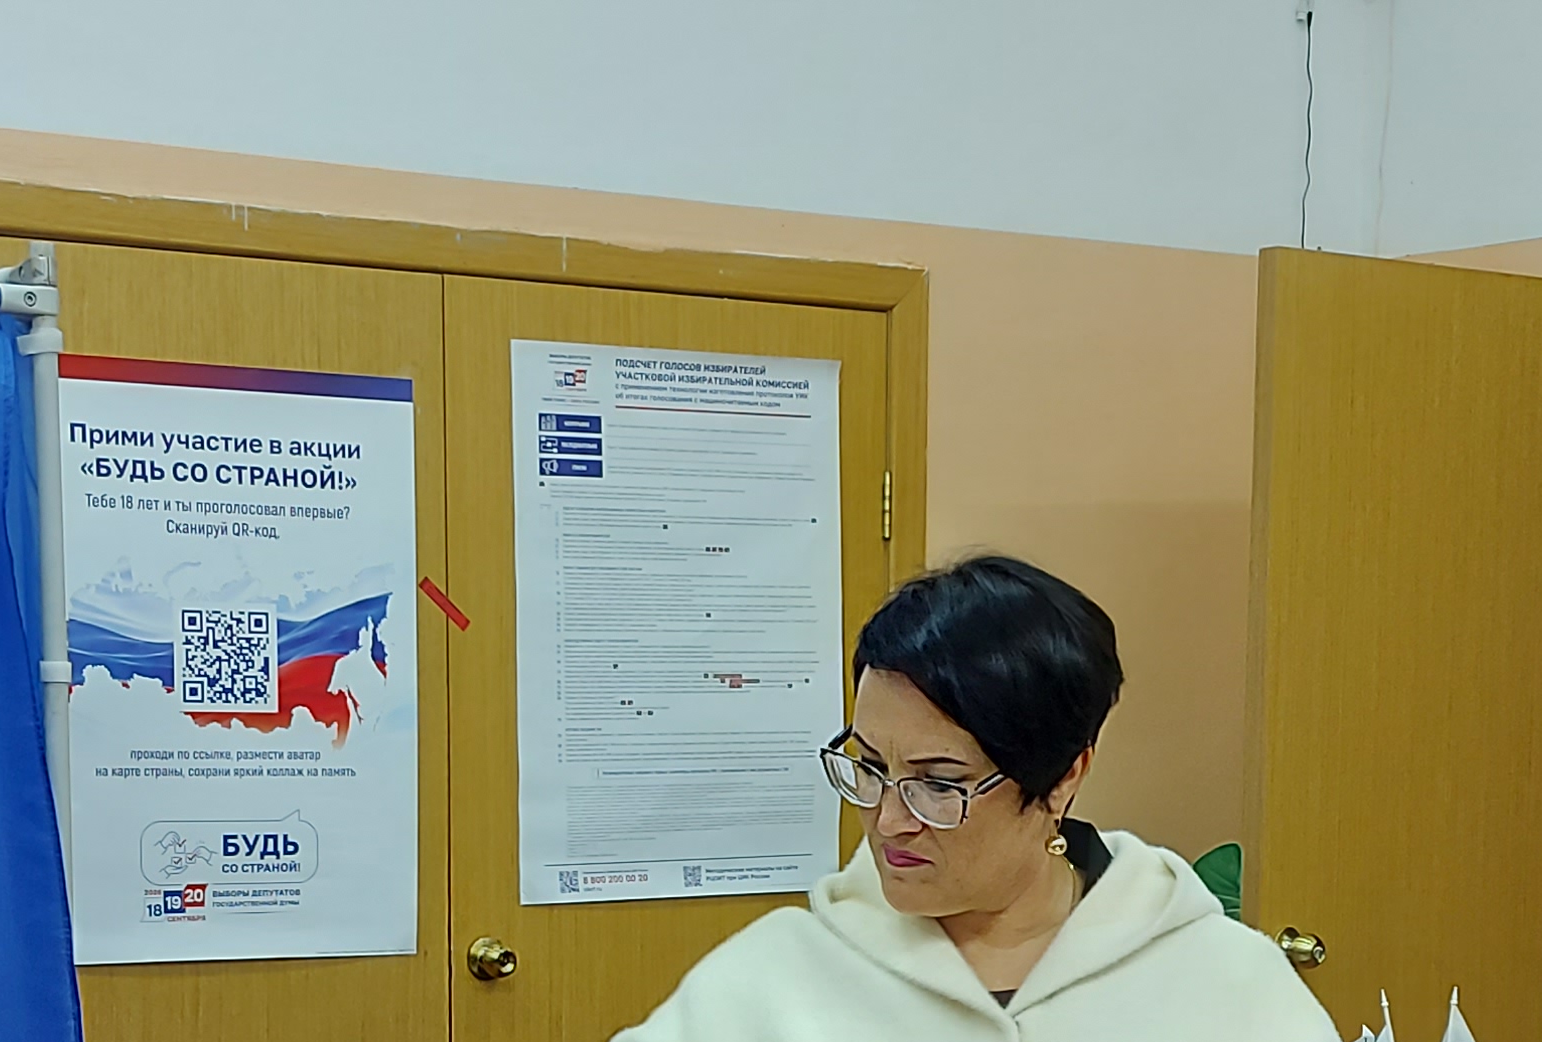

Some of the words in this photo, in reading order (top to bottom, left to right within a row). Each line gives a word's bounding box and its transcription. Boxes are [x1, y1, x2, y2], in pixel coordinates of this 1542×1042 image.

[615, 359, 658, 370] ПОДСЧЕТ
[659, 361, 702, 372] ГОЛОСОВ
[703, 363, 767, 376] ИЗБИРАТЕЛЕЙ
[615, 371, 677, 383] УЧАСТКОВОЙ
[678, 374, 754, 387] ИЗБИРАТЕЛЬНОЙ
[755, 379, 810, 391] КОМИССИЕЙ
[69, 422, 155, 449] Прими
[161, 432, 263, 454] участие
[269, 439, 282, 454] в
[289, 441, 361, 461] акции
[80, 457, 166, 483] «БУДЬ
[172, 462, 208, 483] СО
[216, 463, 358, 491] СТРАНОЙ!»
[85, 493, 117, 509] Тебе
[120, 495, 134, 510] 18
[137, 498, 160, 511] лет
[164, 499, 172, 511] и
[176, 500, 192, 512] ты
[196, 501, 287, 518] проголосовал
[289, 506, 351, 522] впервые?
[166, 519, 228, 539] Сканируй
[130, 749, 175, 761] проходи
[177, 749, 190, 761] по
[236, 749, 285, 762] размести
[286, 749, 321, 762] аватар
[95, 767, 109, 777] на
[111, 766, 141, 779] карте
[188, 766, 231, 779] сохрани
[233, 765, 264, 779] яркий
[266, 766, 304, 778] коллаж
[306, 766, 319, 777] на
[321, 765, 357, 778] память
[221, 833, 301, 860] БУДЬ
[221, 863, 239, 873] СО
[241, 860, 301, 873] СТРАНОЙ!
[146, 903, 163, 917] 18
[165, 895, 182, 910] 19
[184, 888, 204, 903] 20
[212, 889, 250, 898] ВЫБОРЫ
[251, 889, 301, 898] ДЕПУТАТОВ
